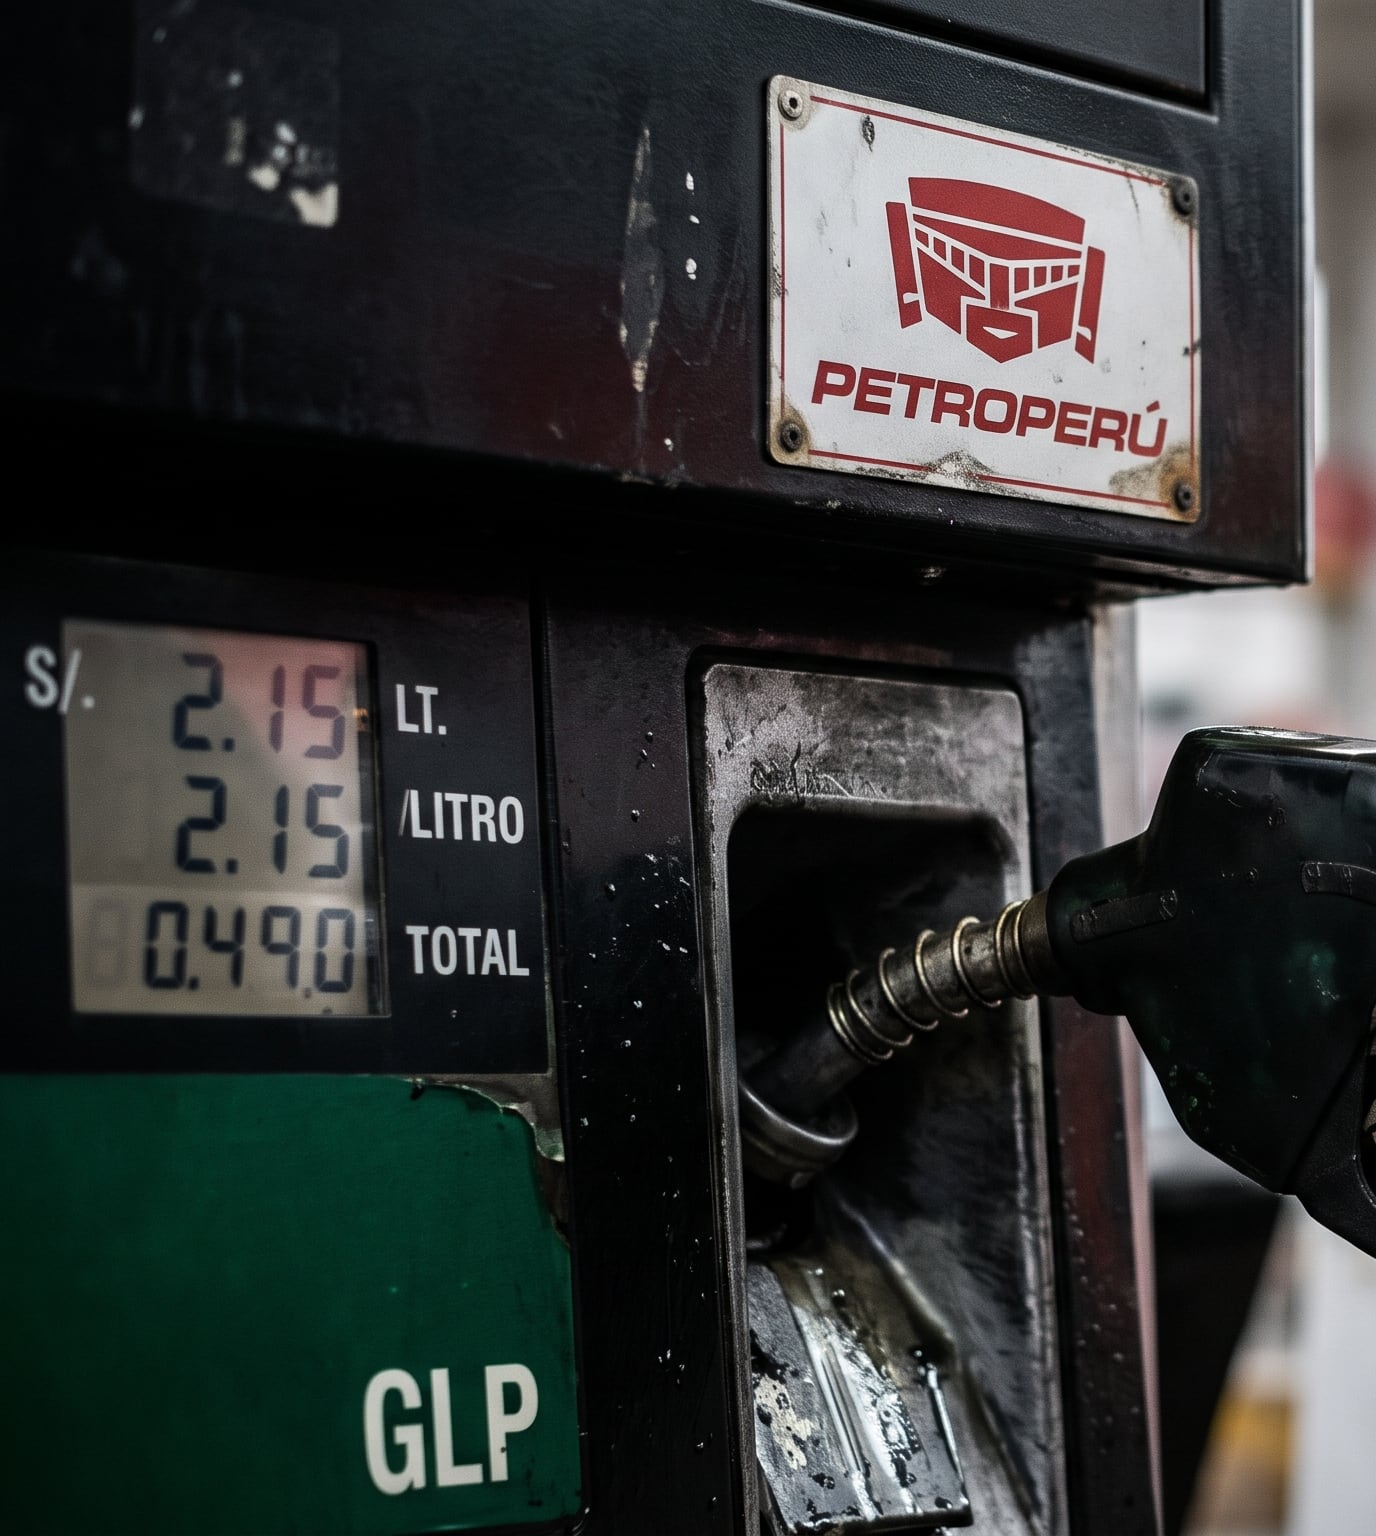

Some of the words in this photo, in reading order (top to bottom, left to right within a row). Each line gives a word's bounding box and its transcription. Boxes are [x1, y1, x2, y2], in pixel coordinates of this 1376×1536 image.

[811, 360, 1168, 458] PETROPERÚ
[25, 645, 96, 714] S/.
[172, 652, 347, 760] 2.15
[396, 683, 448, 736] LT.
[176, 775, 350, 879] 2.15
[400, 788, 525, 844] /LITRO
[405, 925, 530, 977] TOTAL
[364, 1363, 539, 1496] GLP
